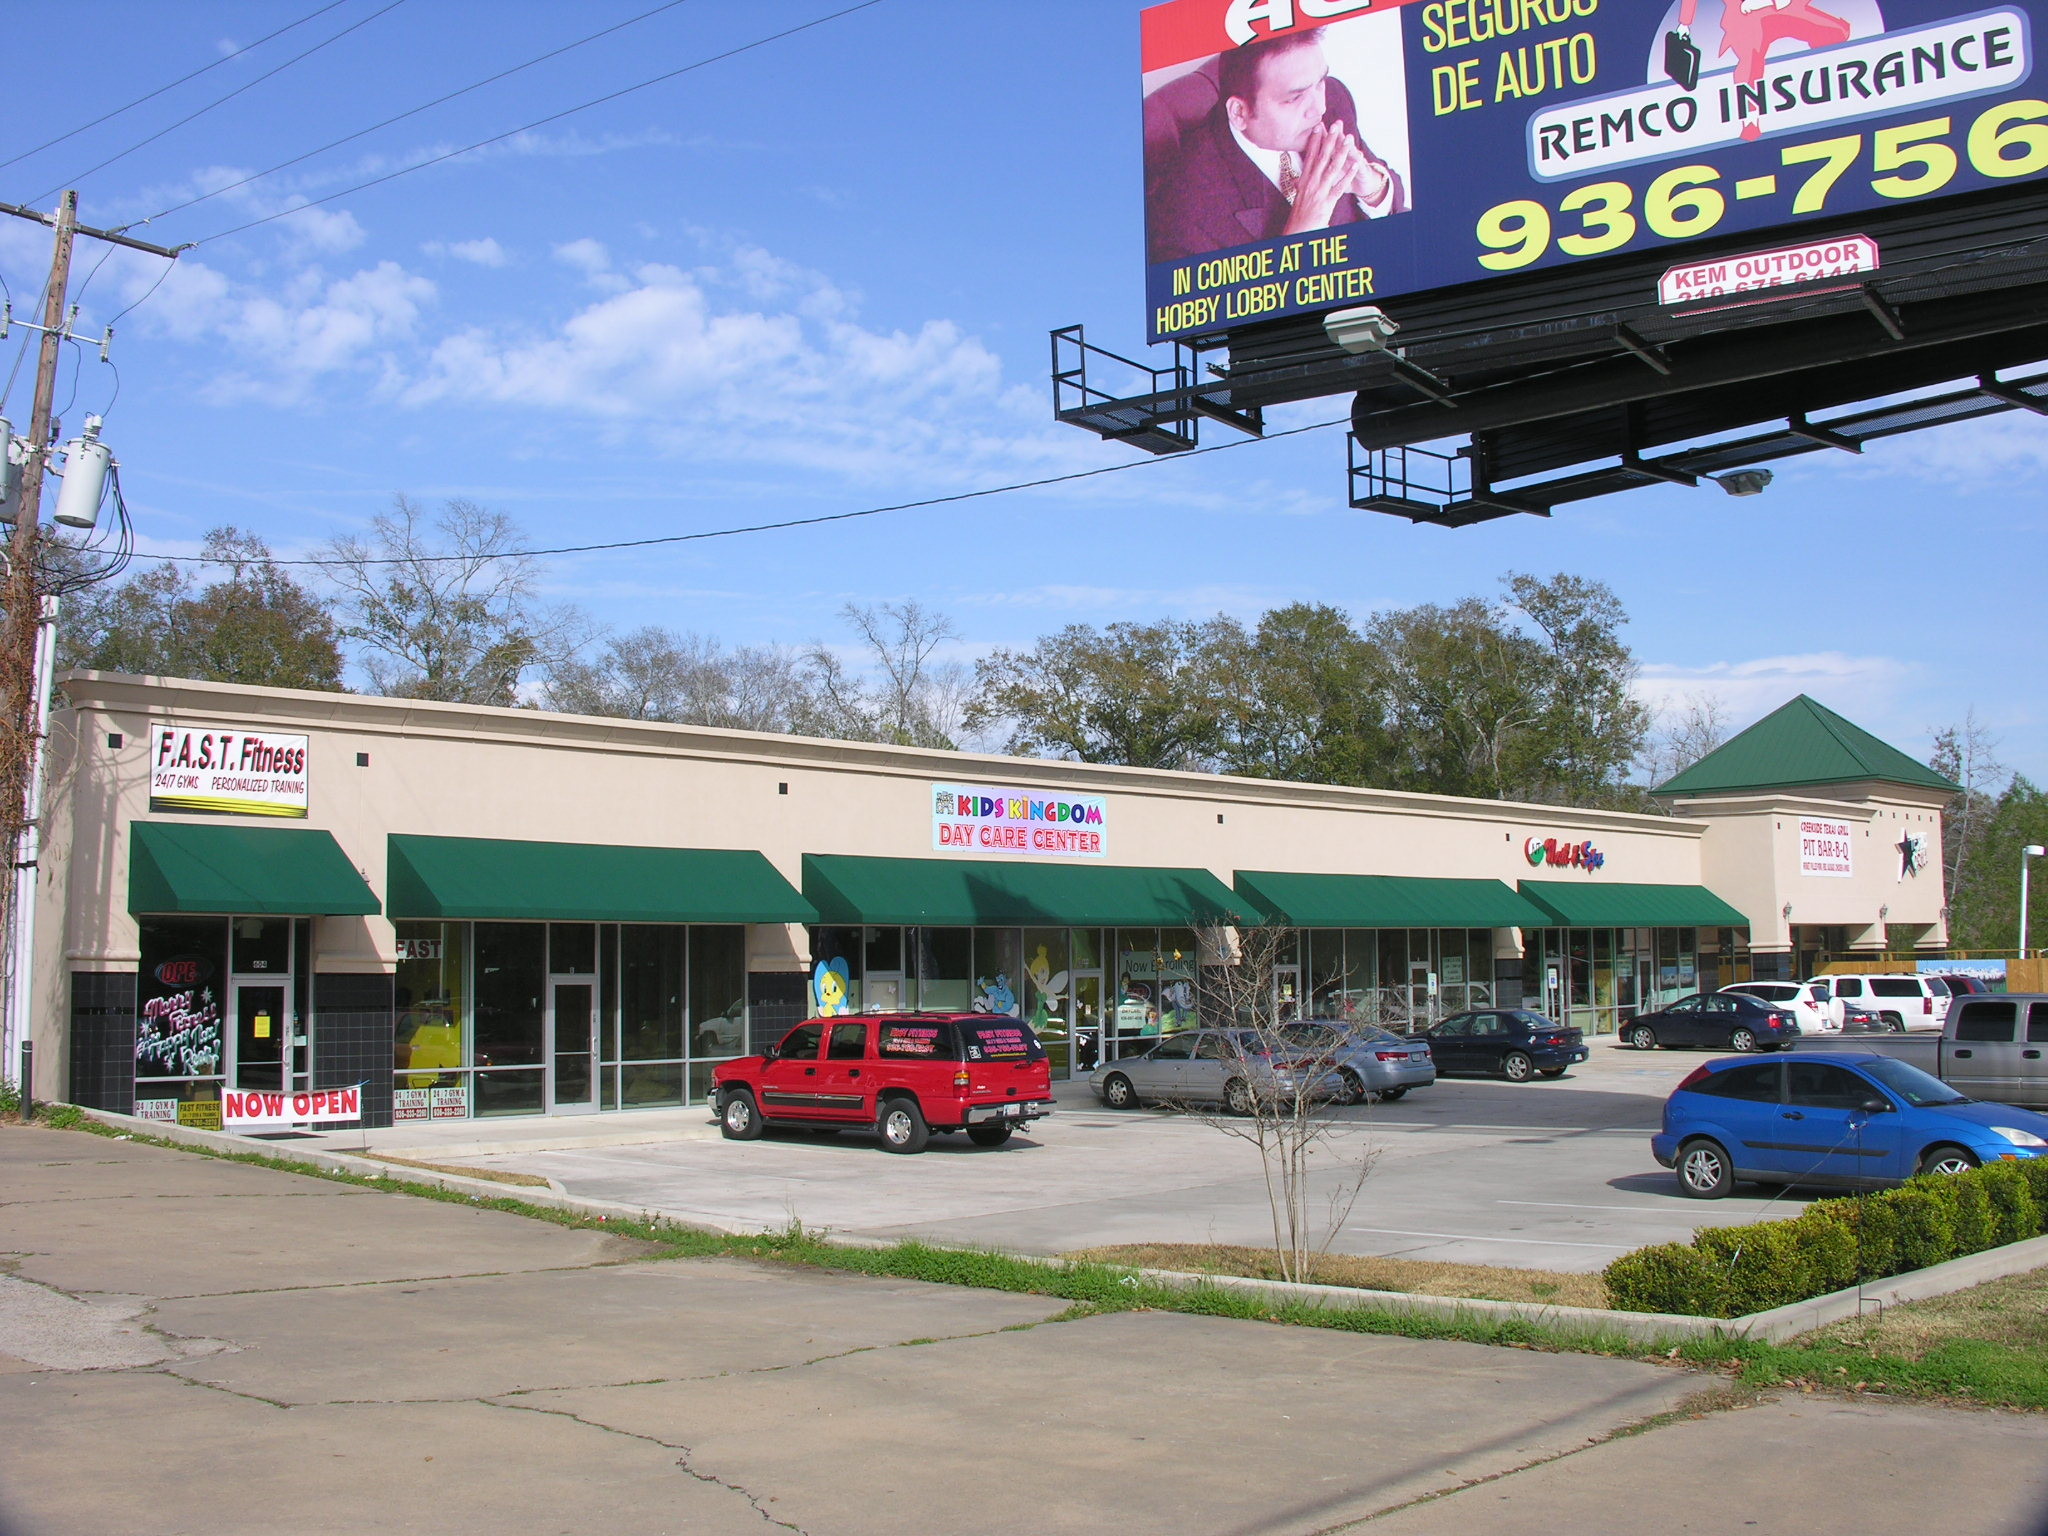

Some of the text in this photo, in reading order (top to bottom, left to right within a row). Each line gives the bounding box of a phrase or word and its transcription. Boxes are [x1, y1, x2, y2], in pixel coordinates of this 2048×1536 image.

[1431, 32, 1597, 117] DE AUTO
[1538, 27, 2015, 162] REMCO INSURANCE
[1172, 234, 1349, 296] IN CONROE AT THE
[1675, 243, 1861, 290] KEM OUTDOOR
[1156, 266, 1375, 334] HOBBY LOBBY CENTER
[158, 731, 305, 774] F.A.S.T. Fitness
[154, 774, 305, 794] 24/7 GYMS PERSONALIZED TRAINING
[957, 794, 1103, 825] KIDS KINGDOM
[939, 823, 1101, 853] DAY CARE CENTER
[1803, 838, 1849, 861] PIT BAR-B-Q
[396, 940, 441, 958] FAST
[1125, 960, 1148, 972] Now
[140, 1110, 171, 1119] TRAINING
[226, 1089, 358, 1118] NOW OPEN
[399, 1099, 424, 1107] TRAINING
[437, 1098, 462, 1106] TRAINING
